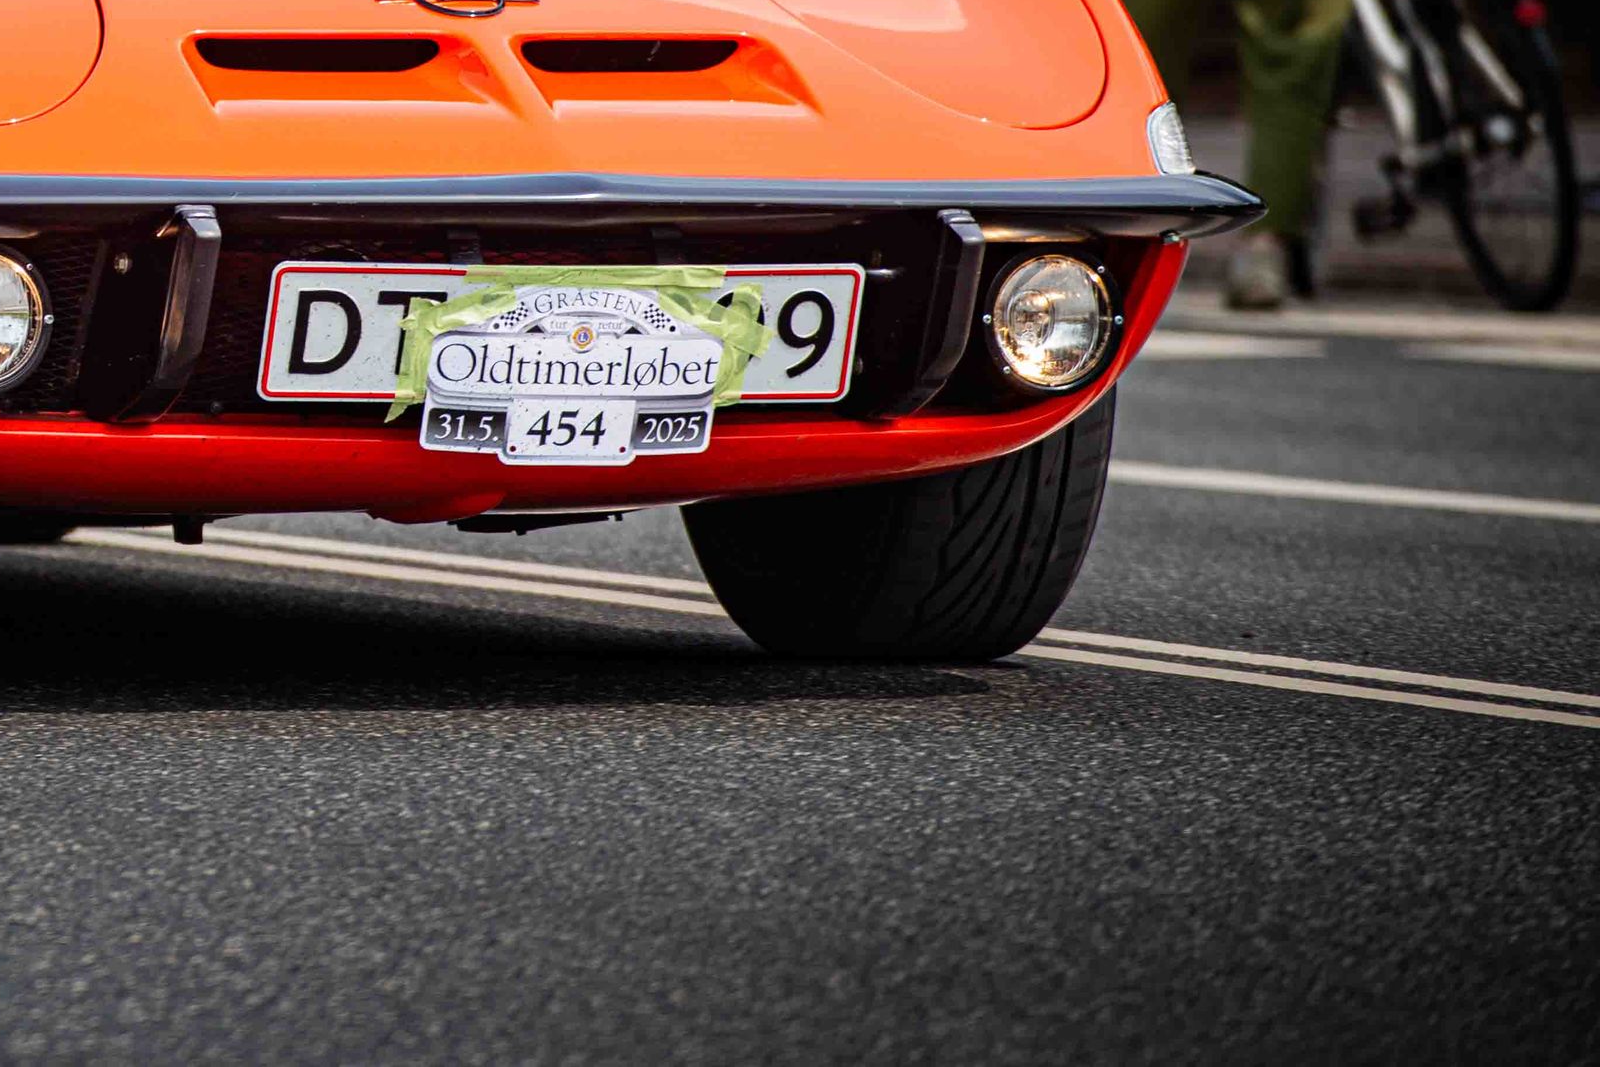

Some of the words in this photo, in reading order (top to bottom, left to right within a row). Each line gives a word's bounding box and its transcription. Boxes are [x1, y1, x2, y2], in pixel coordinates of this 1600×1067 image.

[436, 343, 718, 391] Oldtimerløbet
[434, 413, 499, 442] 31.5.
[526, 409, 606, 446] 454
[641, 415, 702, 443] 2025
